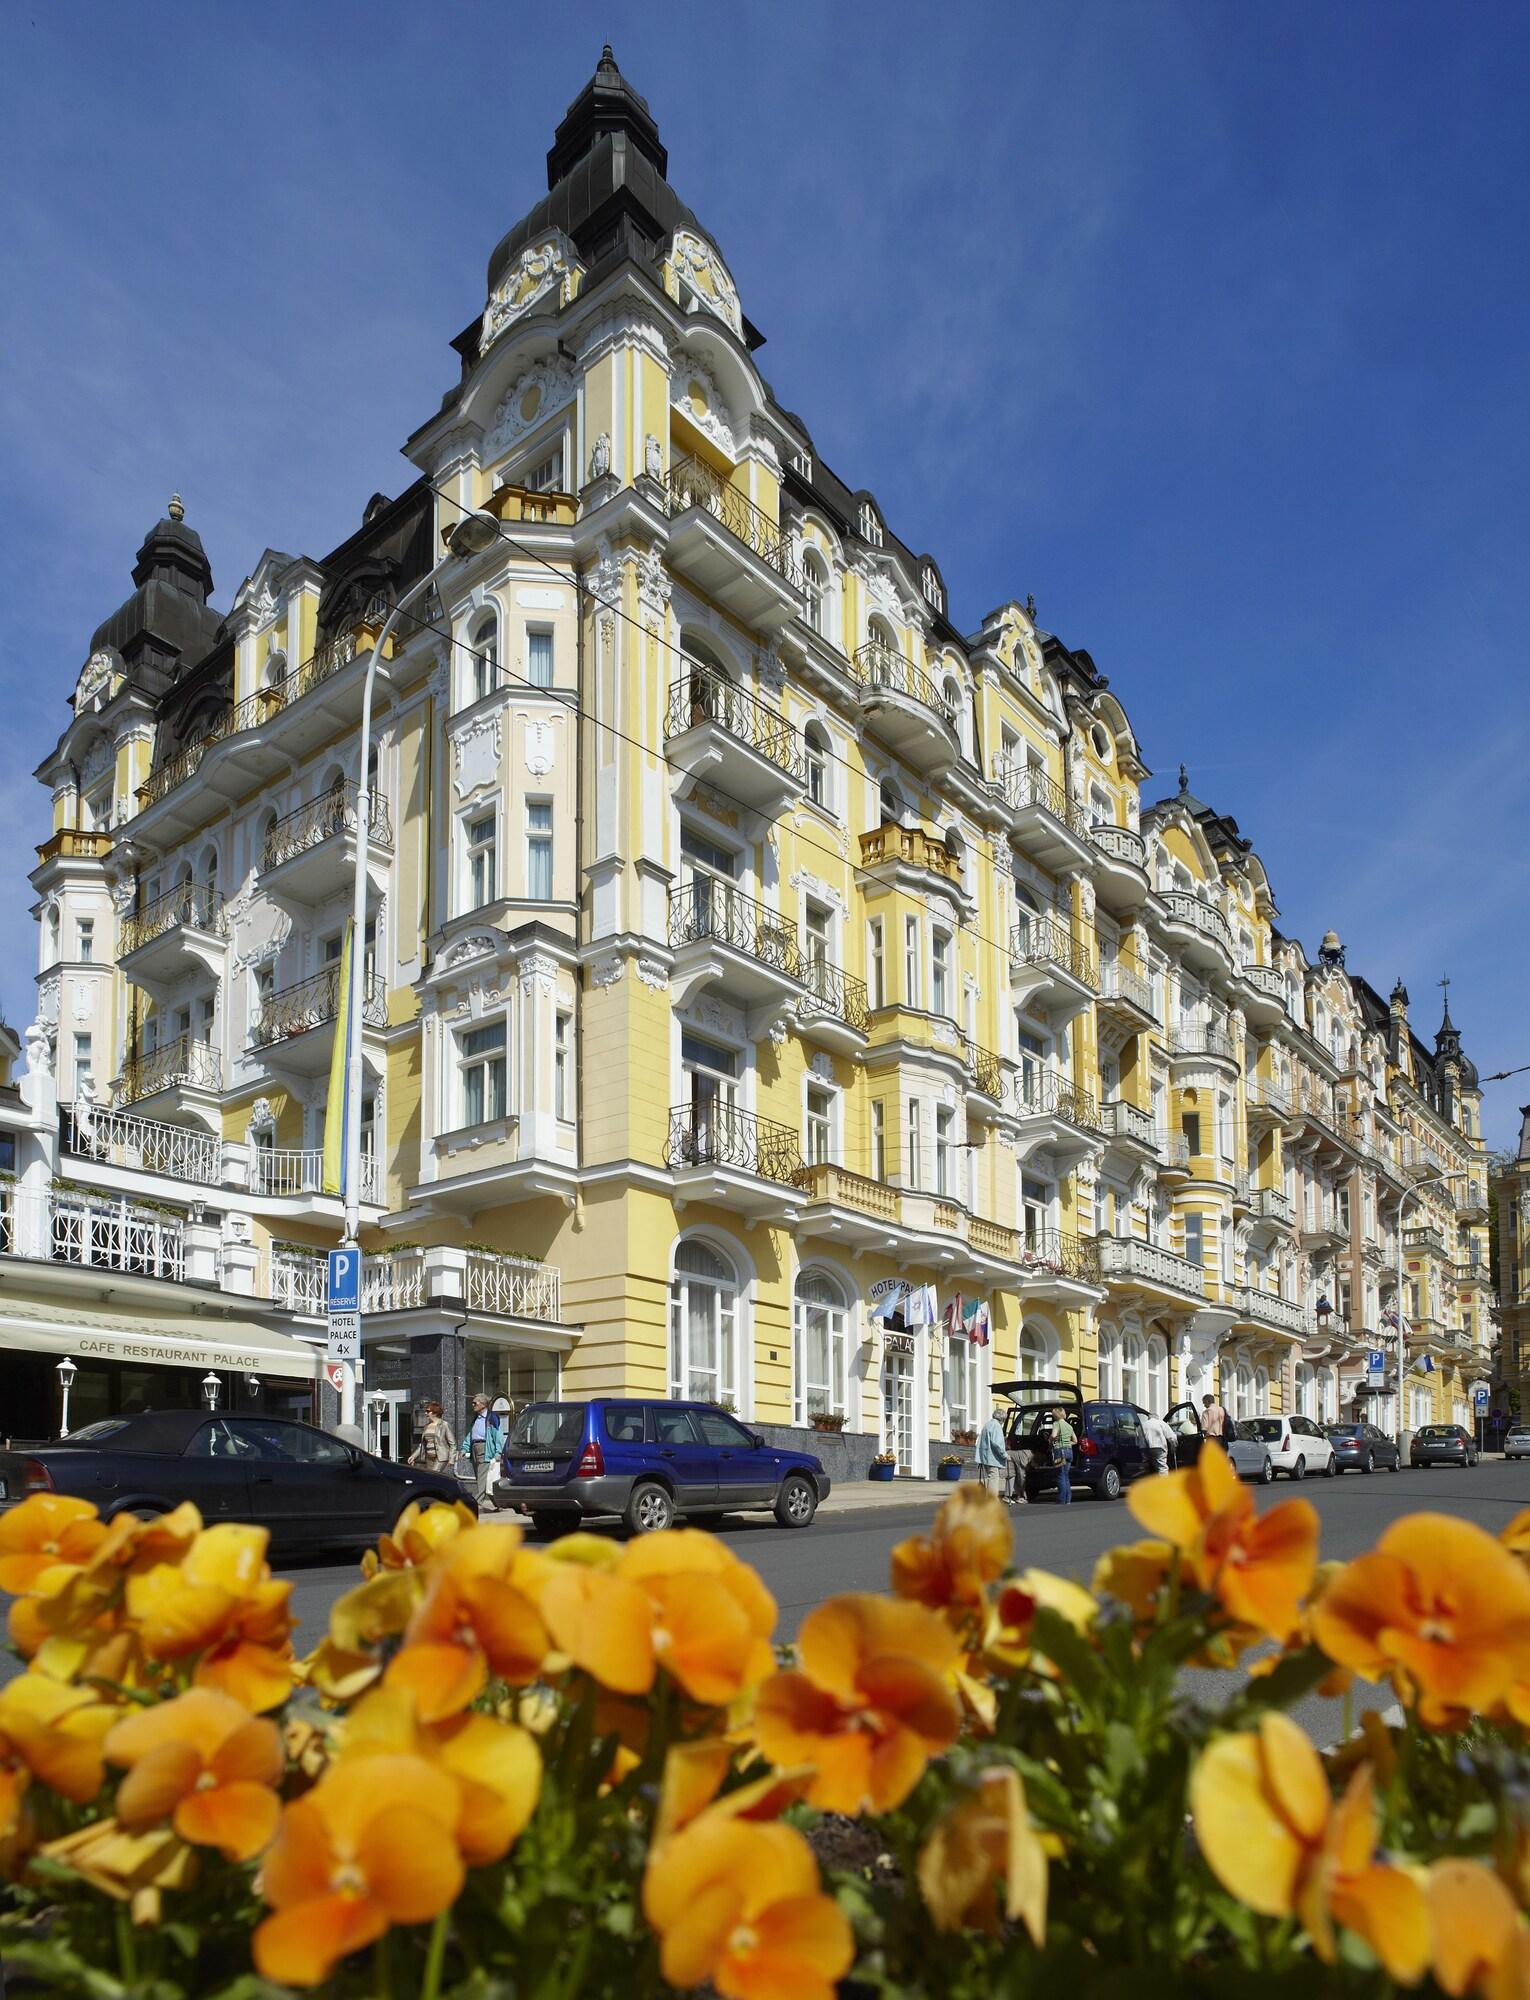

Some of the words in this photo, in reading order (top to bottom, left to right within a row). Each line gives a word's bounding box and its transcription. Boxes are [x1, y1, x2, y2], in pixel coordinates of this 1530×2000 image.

[335, 1254, 350, 1289] P
[871, 1279, 897, 1299] HOTEL
[331, 1317, 355, 1327] HOTEL
[330, 1330, 357, 1340] PALACE
[79, 1340, 116, 1354] CAFE
[123, 1344, 208, 1363] RESTAURANT
[213, 1353, 260, 1368] PALACE
[1372, 1353, 1380, 1365] P
[1477, 1391, 1486, 1401] P
